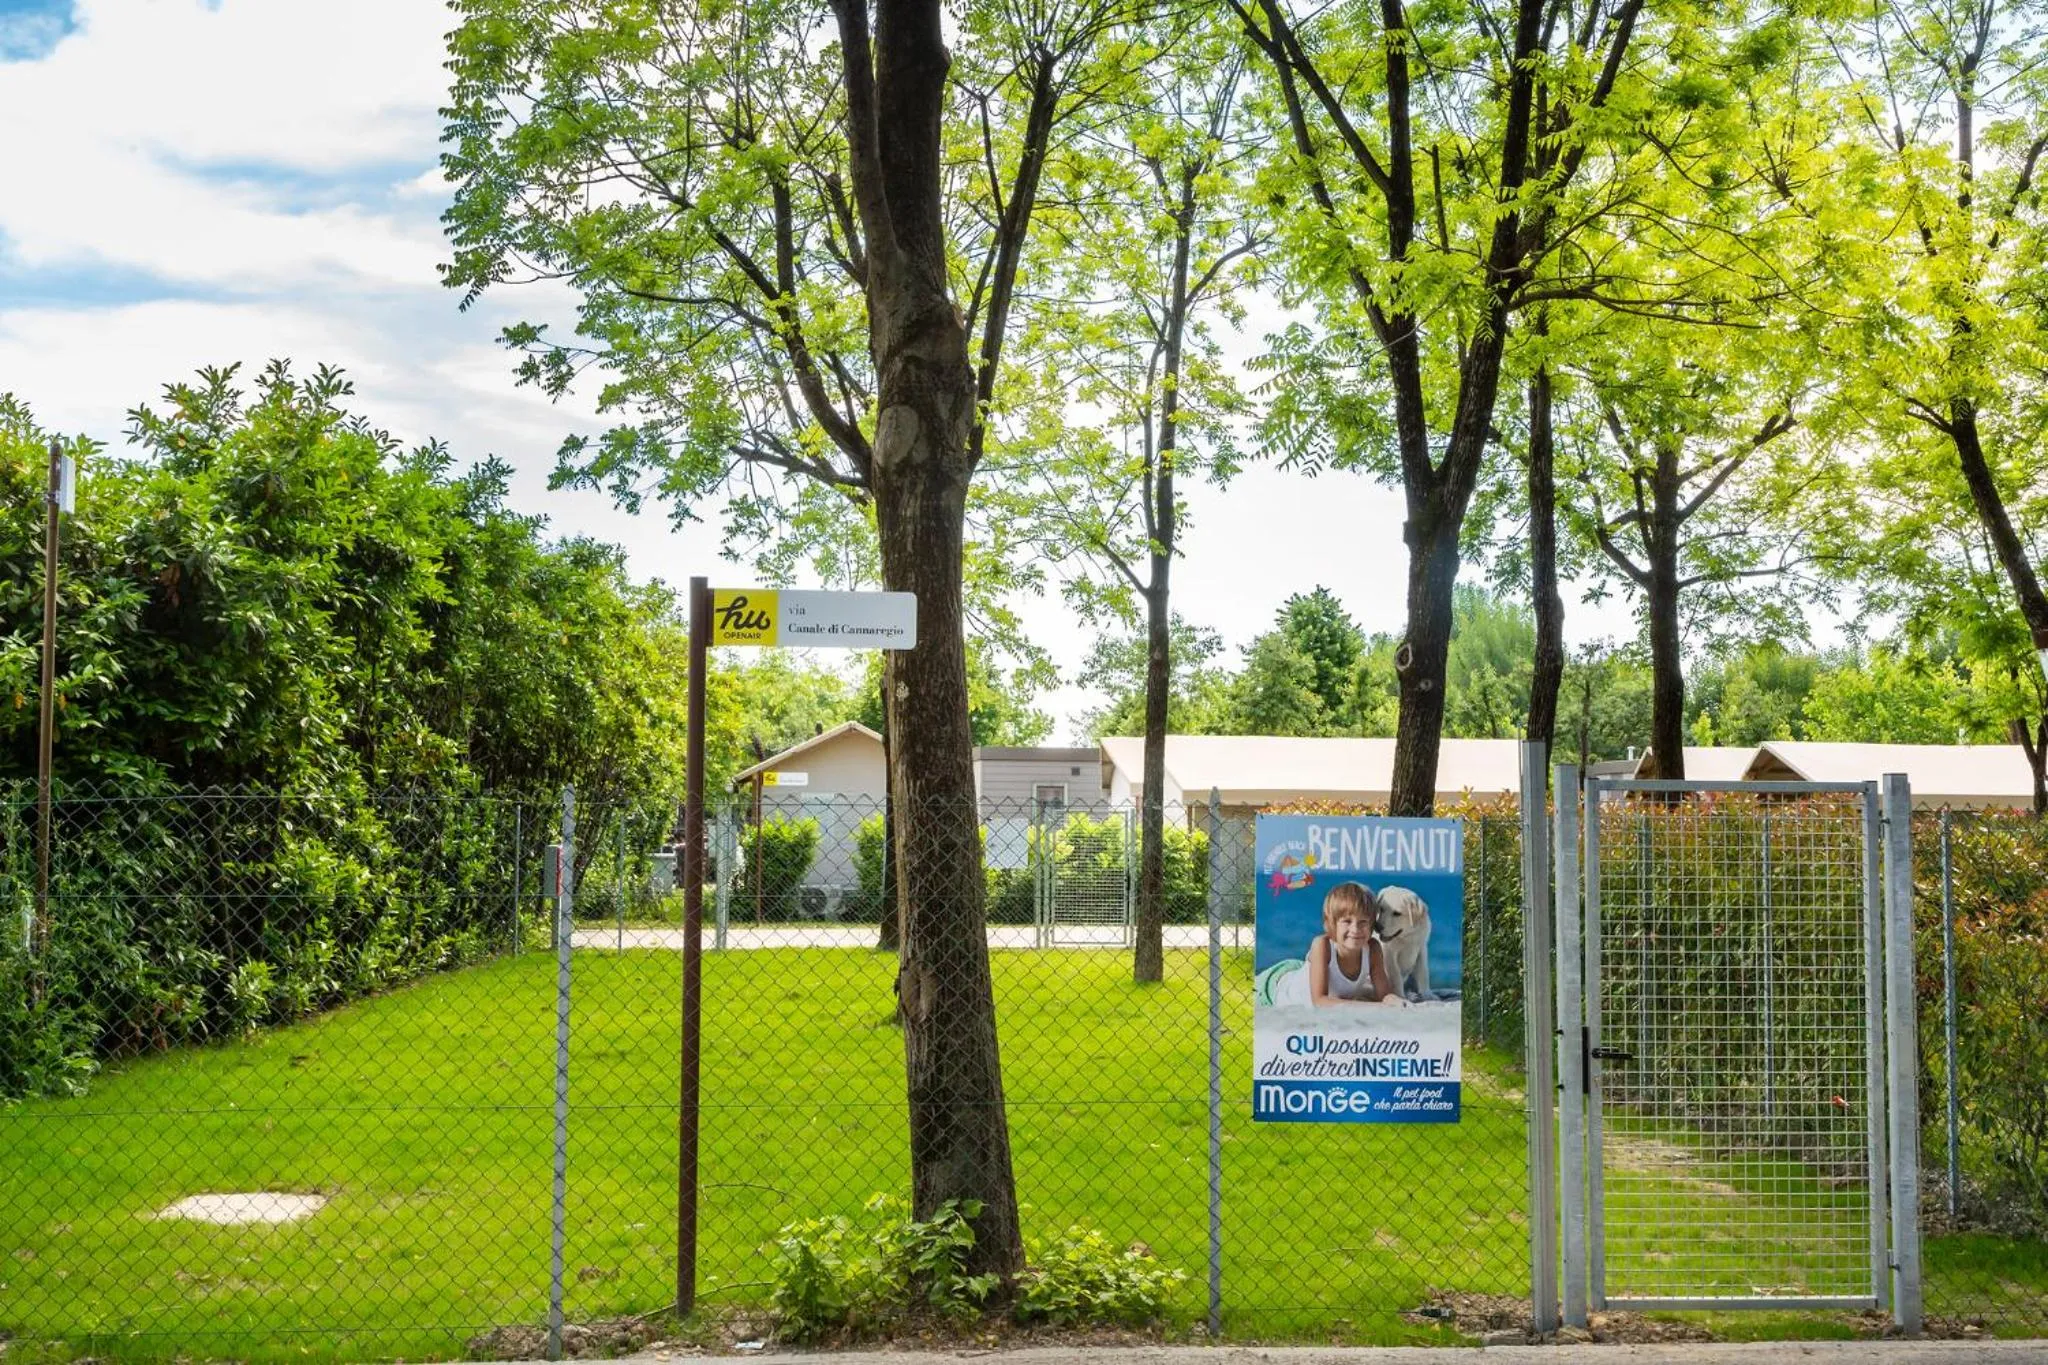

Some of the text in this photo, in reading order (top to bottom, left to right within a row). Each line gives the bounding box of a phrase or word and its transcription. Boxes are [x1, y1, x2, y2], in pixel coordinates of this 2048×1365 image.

[716, 596, 771, 630] hu
[788, 604, 806, 615] via
[723, 632, 762, 640] OPENAIR
[788, 623, 904, 637] Canale di Cannaregio
[1307, 824, 1457, 873] BENVENUTI
[1286, 1035, 1420, 1058] QUI possiamo
[1260, 1054, 1356, 1077] divertirci
[1401, 1087, 1420, 1100] pet
[1418, 1086, 1444, 1102] food
[1373, 1098, 1454, 1113] che parla chiaro
